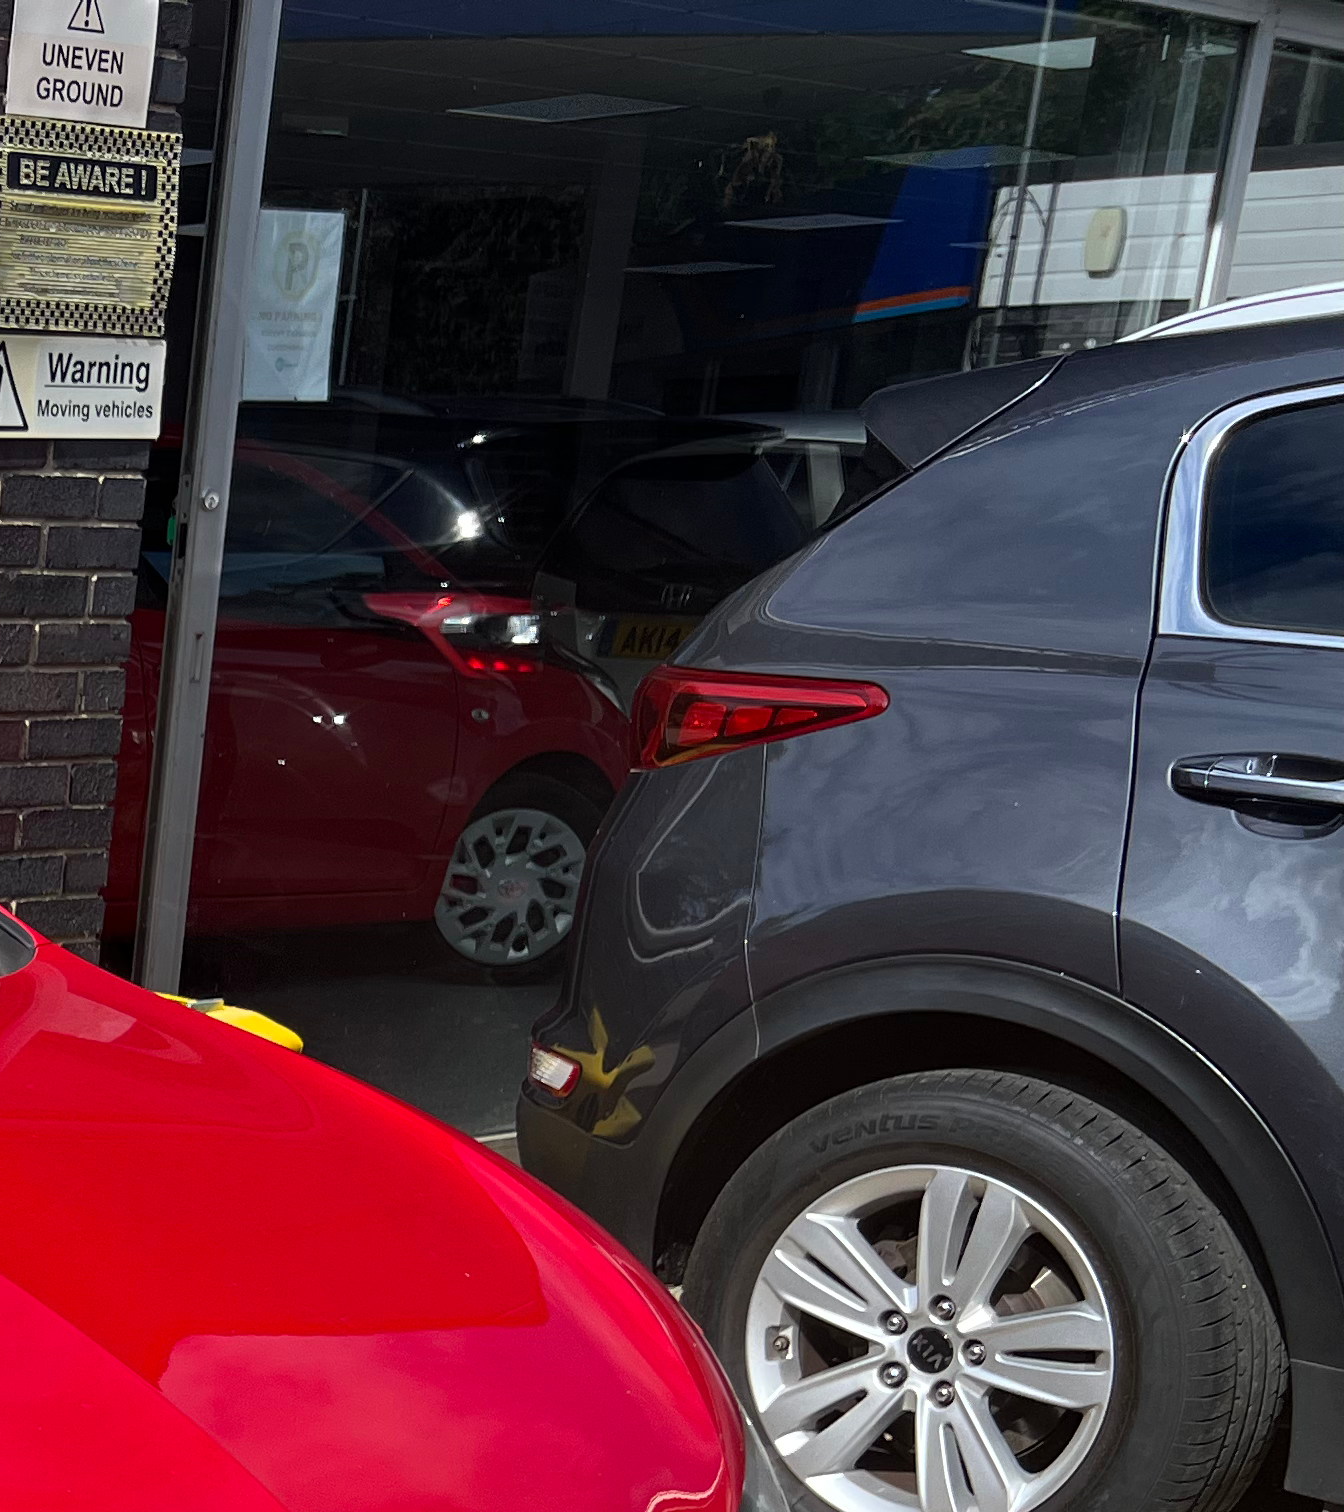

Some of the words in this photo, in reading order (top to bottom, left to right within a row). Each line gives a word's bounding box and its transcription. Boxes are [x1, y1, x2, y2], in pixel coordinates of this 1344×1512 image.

[42, 42, 124, 75] UNEVEN
[36, 76, 123, 107] GROUND
[19, 157, 50, 187] BE
[54, 161, 135, 194] AWARE
[48, 352, 150, 393] Warning
[37, 399, 90, 422] Moving
[95, 400, 153, 418] vehicles
[912, 1333, 943, 1370] KIA
